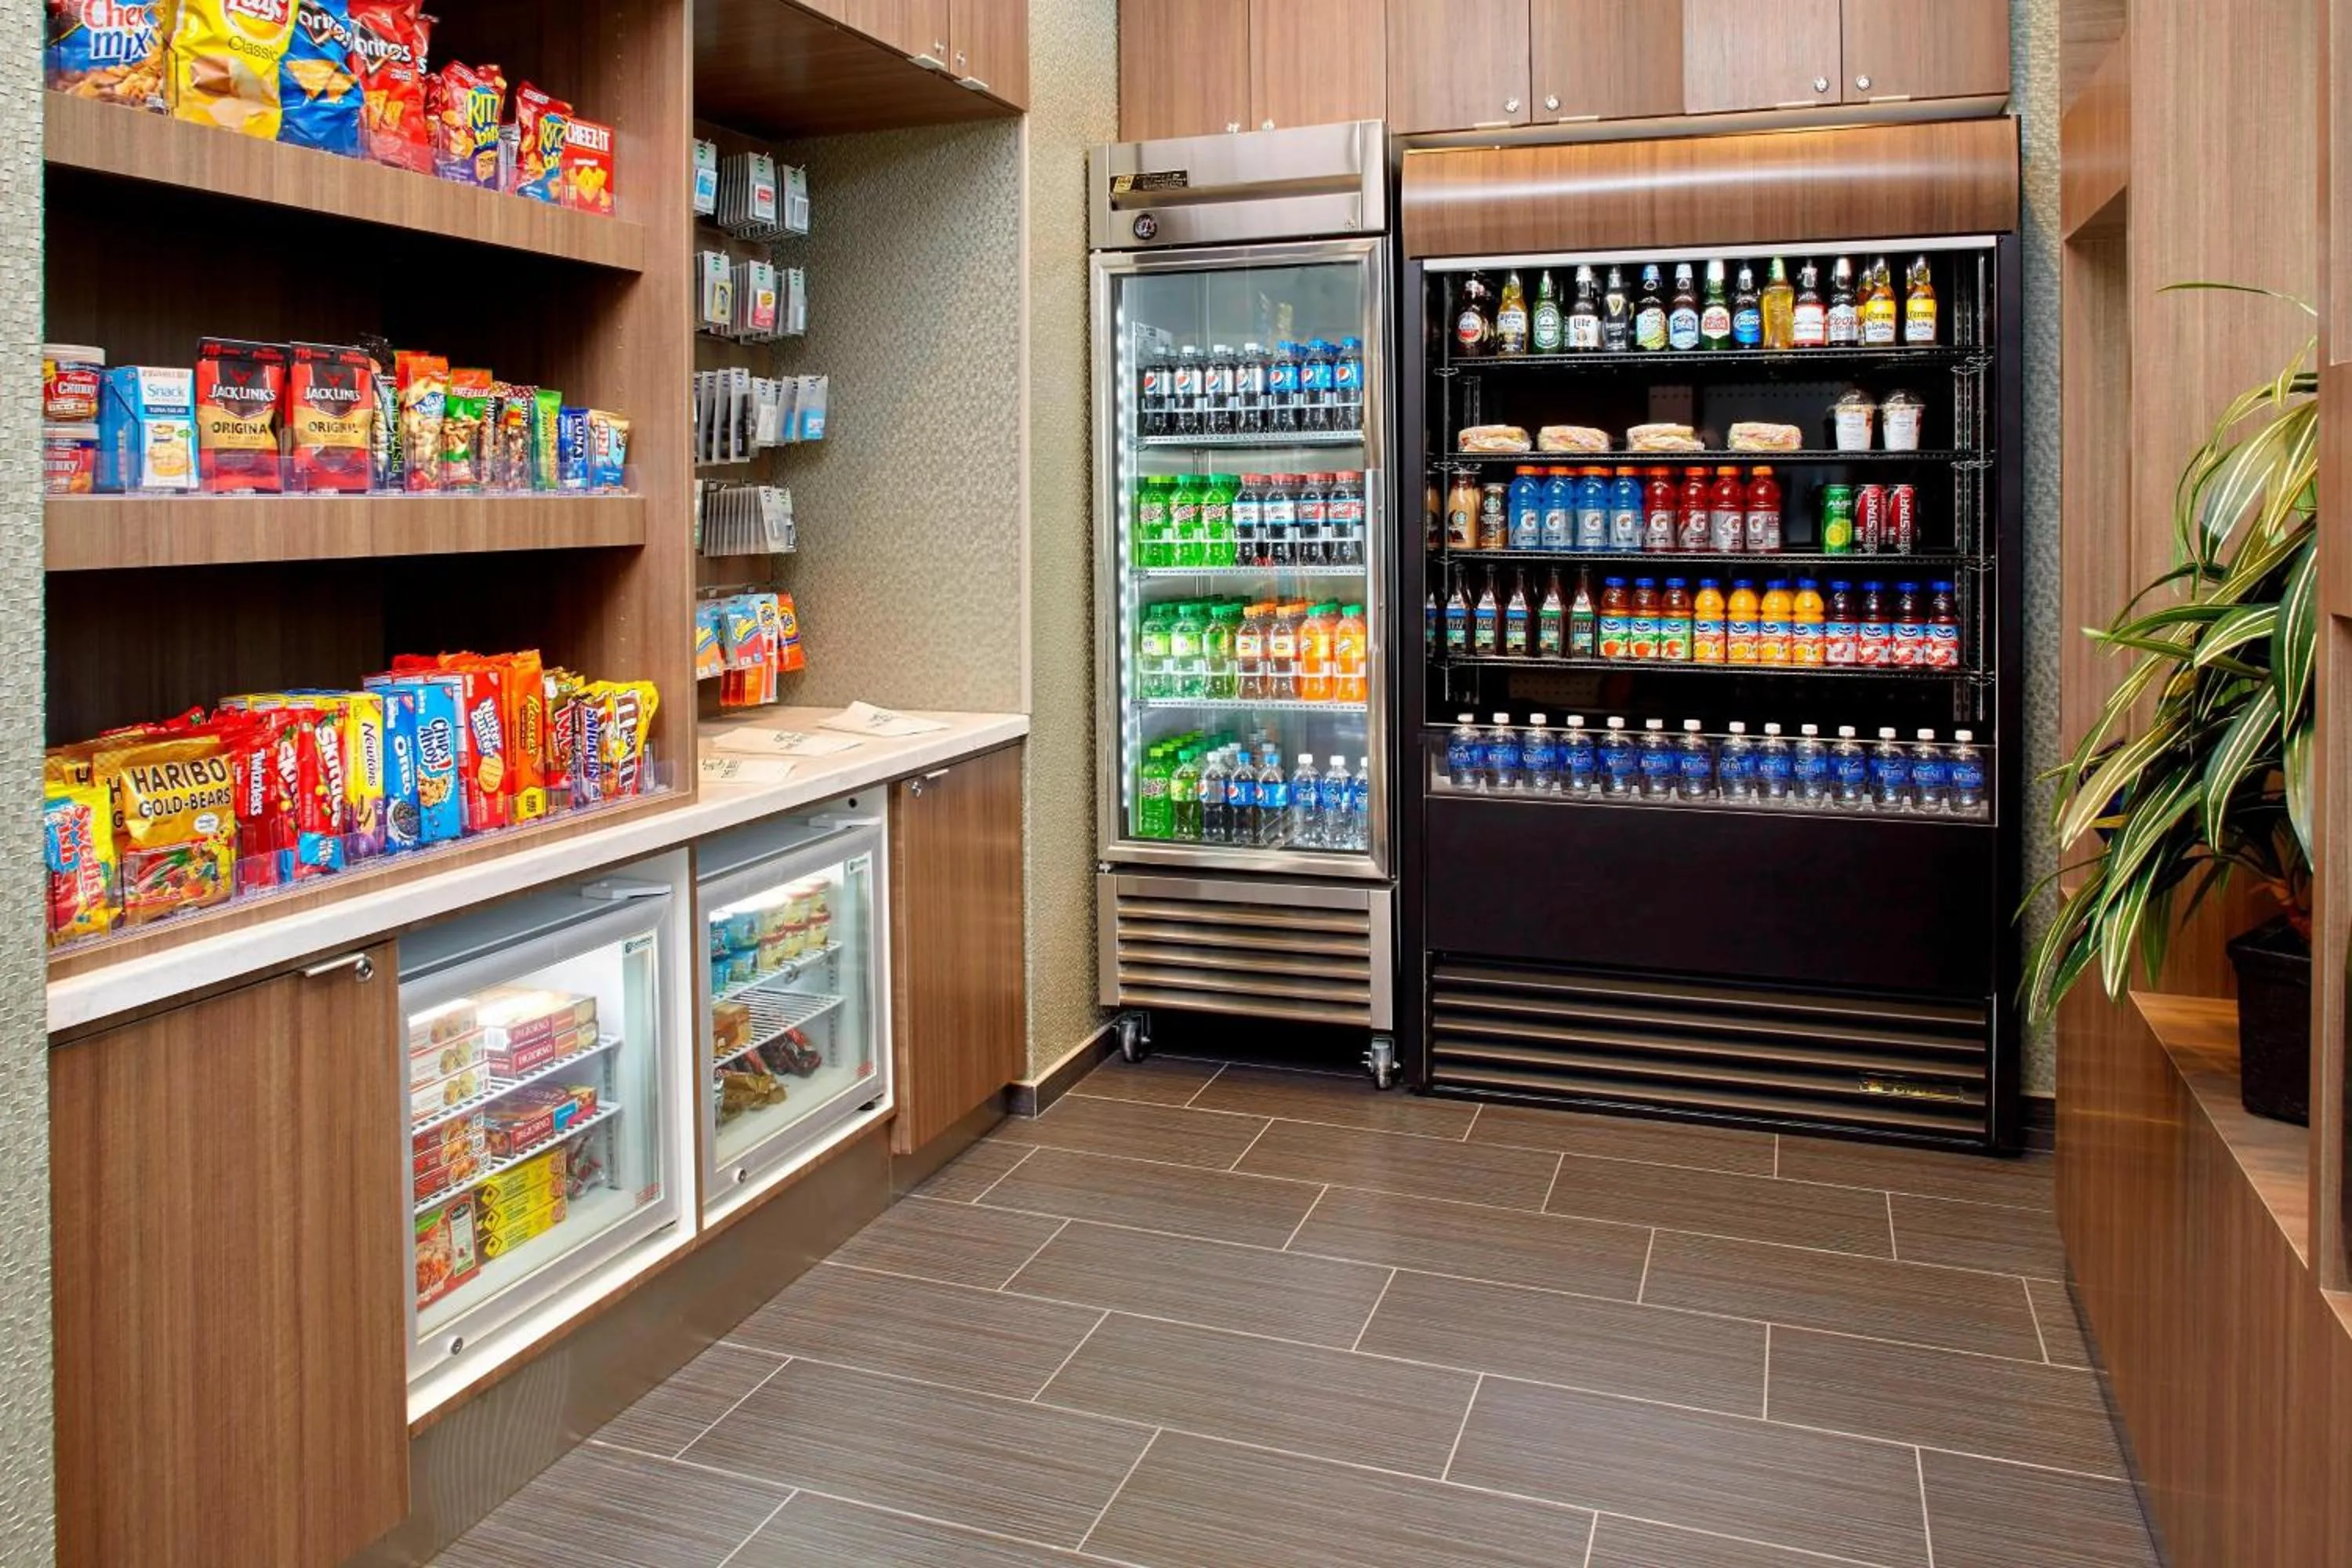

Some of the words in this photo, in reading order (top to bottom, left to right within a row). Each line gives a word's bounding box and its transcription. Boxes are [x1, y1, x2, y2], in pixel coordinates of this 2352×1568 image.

[82, 0, 149, 28] Chex
[298, 9, 352, 49] oritos
[93, 27, 149, 60] mix
[227, 35, 278, 63] Classic
[353, 35, 412, 62] oritos
[209, 383, 239, 400] JACK
[303, 387, 333, 402] JACK
[361, 721, 378, 788] Newtons
[430, 718, 451, 760] Chips
[131, 757, 227, 795] HARIBO
[138, 786, 231, 820] GOLD-BEARS
